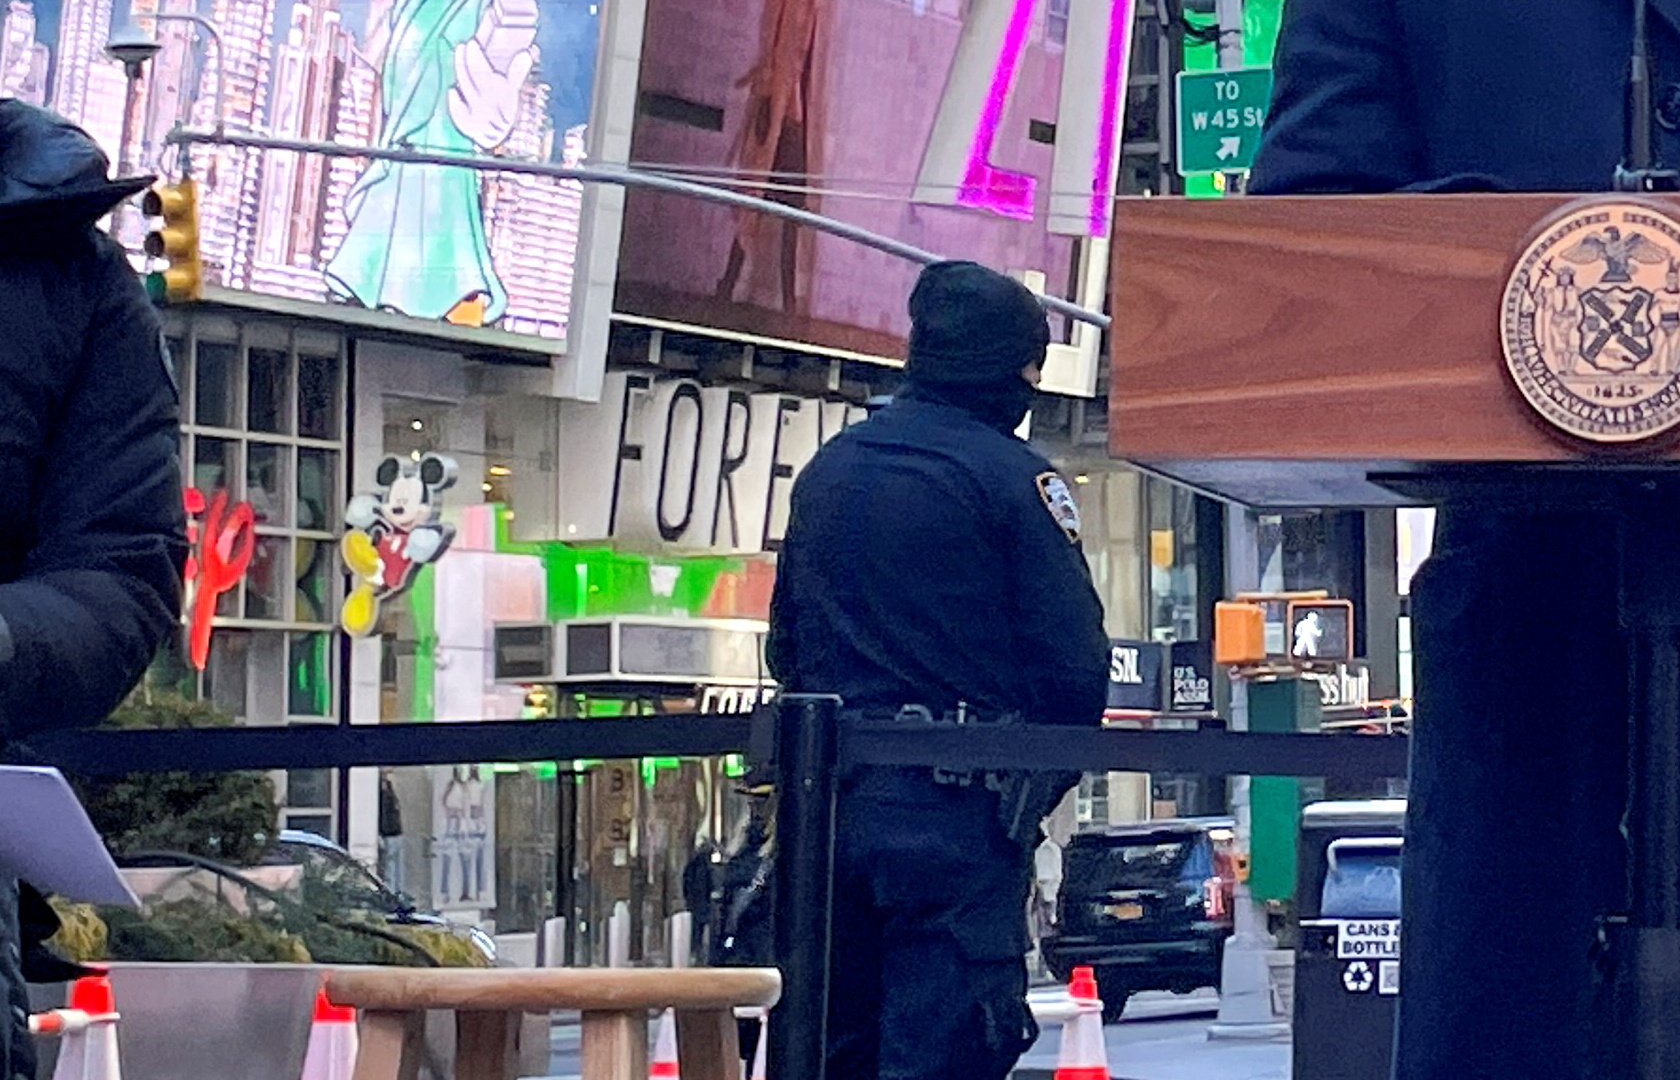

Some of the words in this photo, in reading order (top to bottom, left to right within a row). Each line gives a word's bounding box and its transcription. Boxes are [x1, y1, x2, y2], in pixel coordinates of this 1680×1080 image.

[1214, 80, 1240, 101] TO
[1191, 111, 1209, 131] W
[1211, 108, 1240, 129] 45
[607, 375, 850, 552] FORE
[1346, 924, 1390, 936] CANS
